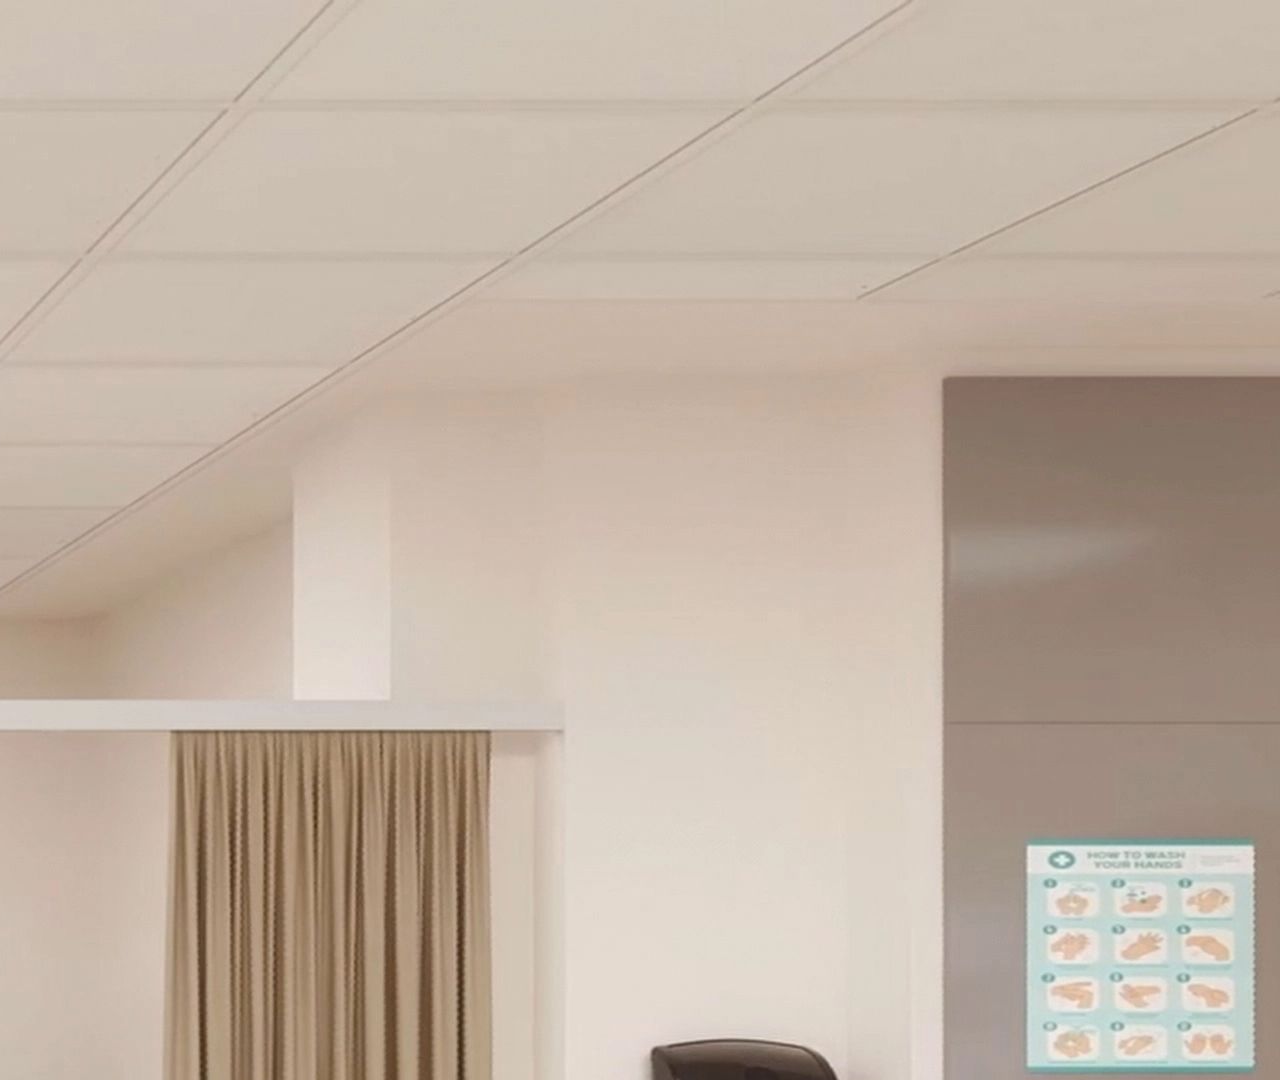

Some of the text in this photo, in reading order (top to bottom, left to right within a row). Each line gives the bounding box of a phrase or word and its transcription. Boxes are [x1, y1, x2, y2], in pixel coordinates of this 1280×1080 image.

[1087, 851, 1186, 859] HOW TO WASH
[1094, 861, 1183, 869] YOUR HANDS
